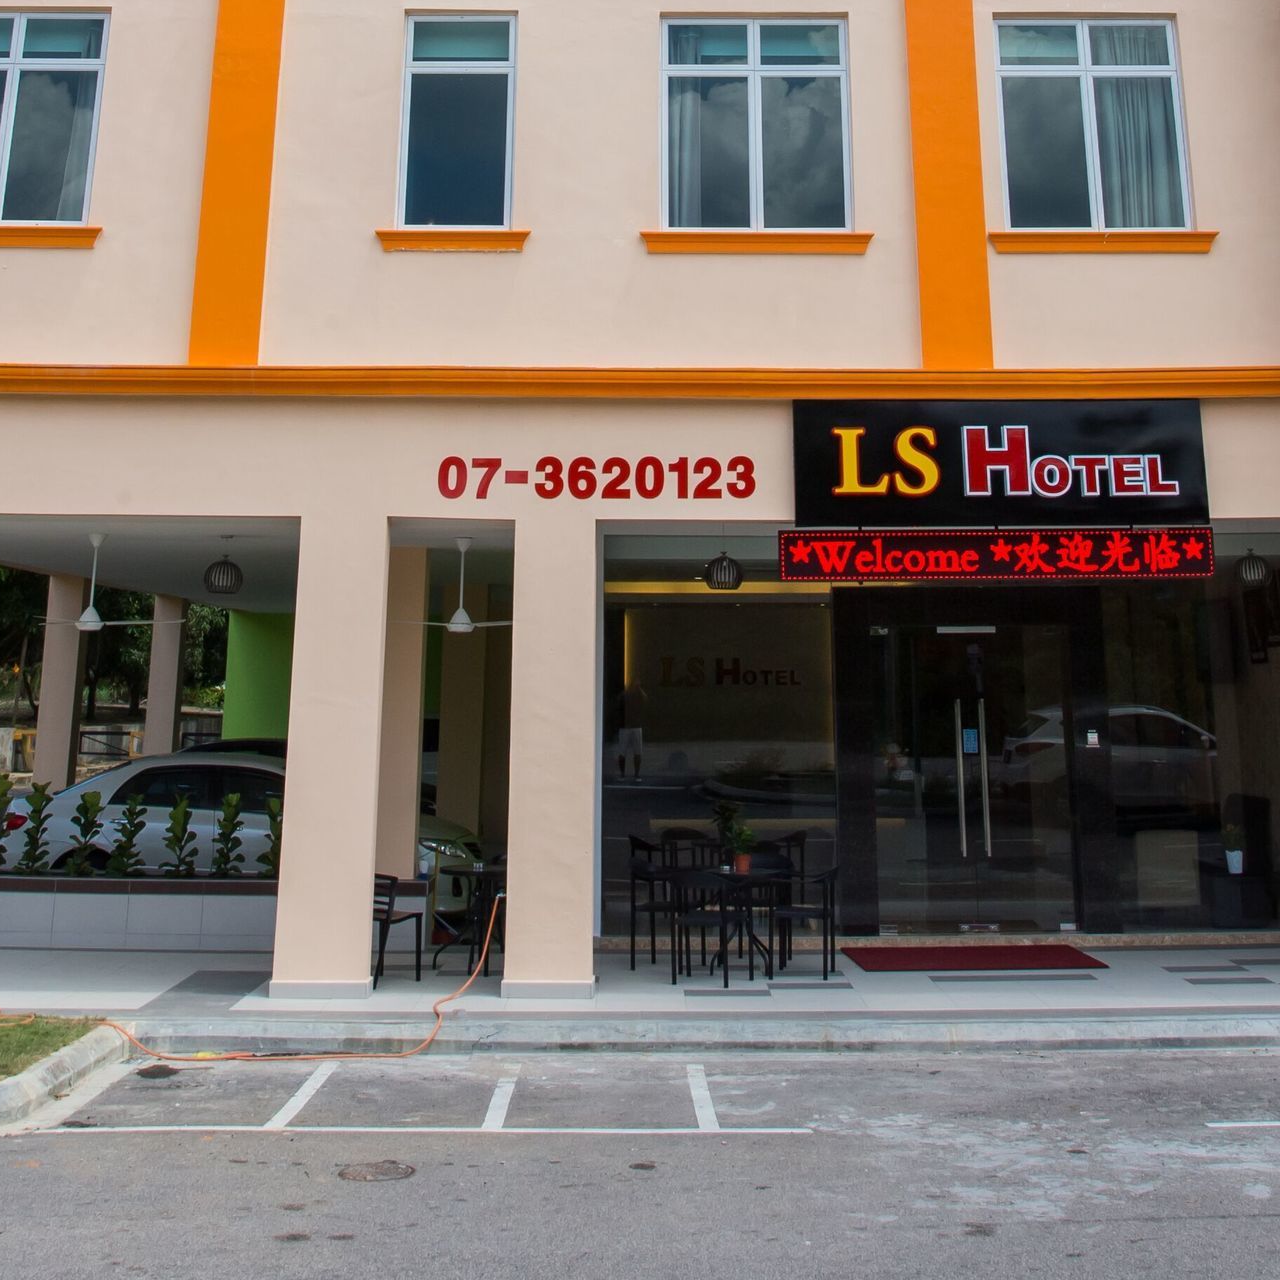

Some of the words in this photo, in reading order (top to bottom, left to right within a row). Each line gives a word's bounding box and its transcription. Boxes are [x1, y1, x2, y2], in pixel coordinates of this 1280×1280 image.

[437, 456, 756, 499] 07-3620123
[831, 425, 941, 497] LS
[961, 425, 1181, 498] HOTEL
[809, 538, 980, 573] Welcome
[1014, 532, 1182, 573] 欢迎光临
[658, 656, 706, 688] LS
